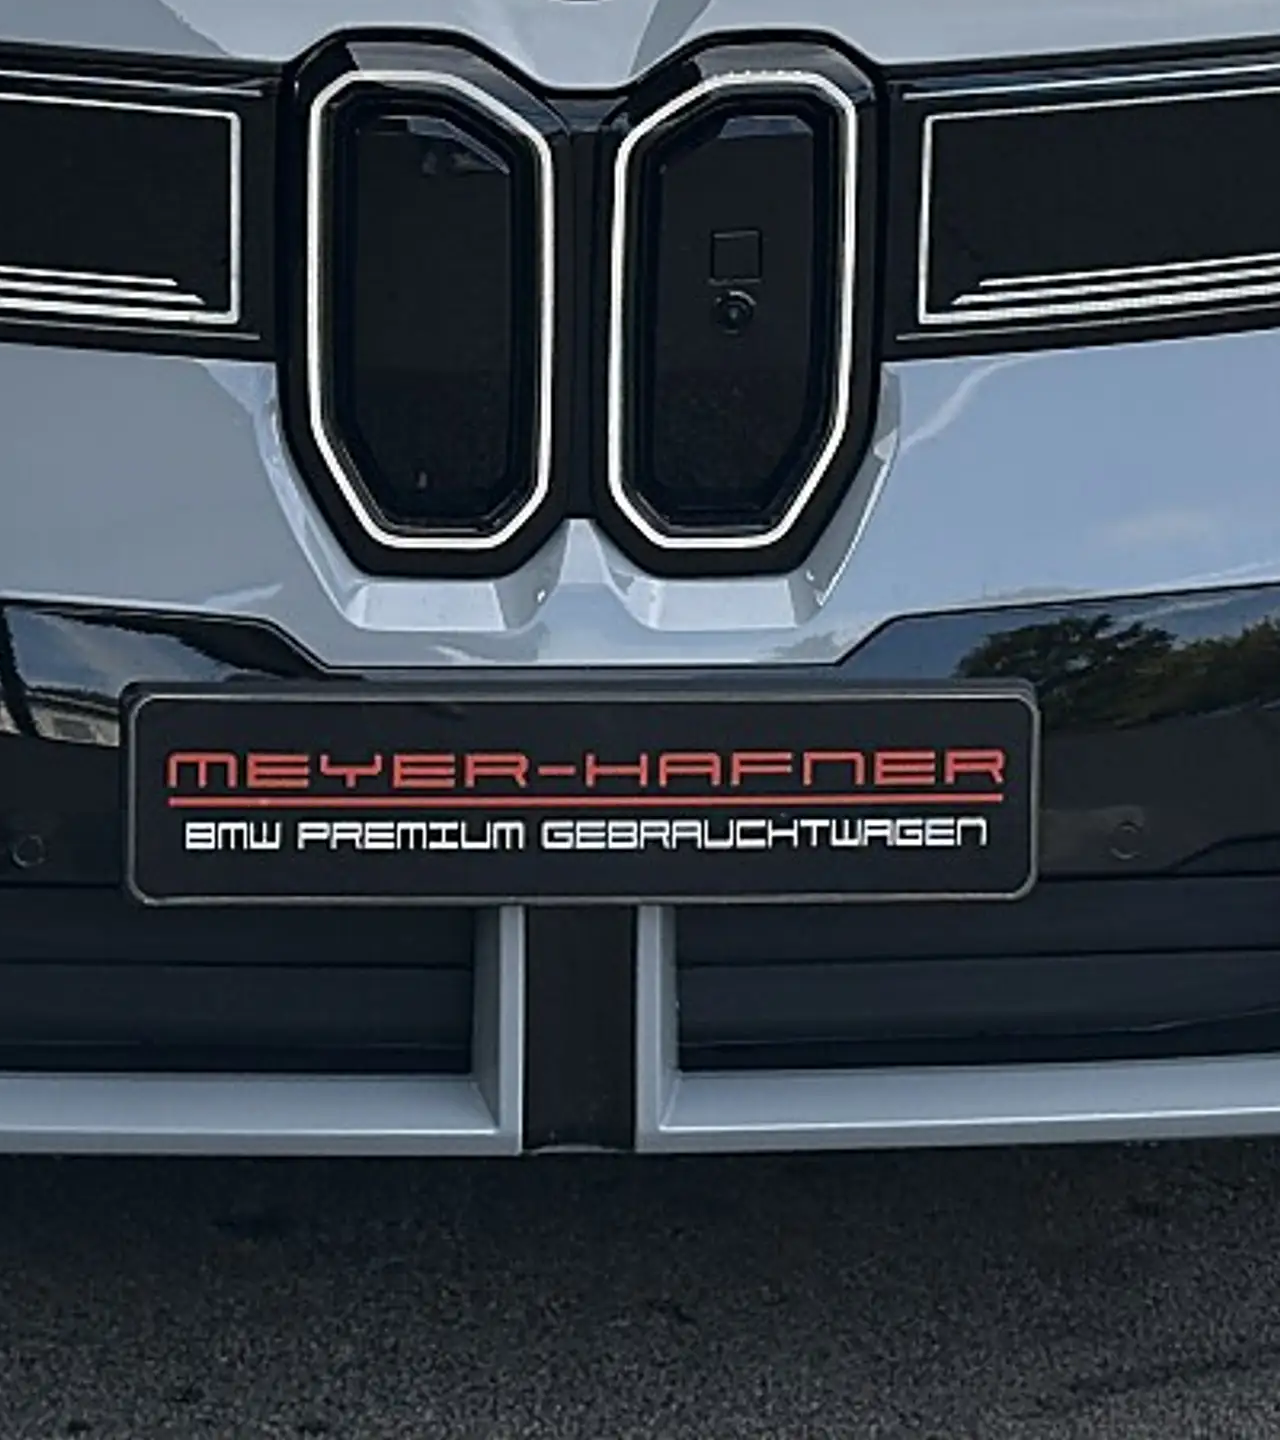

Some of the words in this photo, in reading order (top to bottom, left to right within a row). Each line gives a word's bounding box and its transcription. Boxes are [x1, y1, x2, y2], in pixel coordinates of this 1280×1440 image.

[167, 750, 1005, 788] MEYER-HAFNER
[184, 820, 281, 850] BMW
[297, 819, 525, 850] PREMIUM
[540, 816, 988, 849] GEBRAUCHTWAGEN
